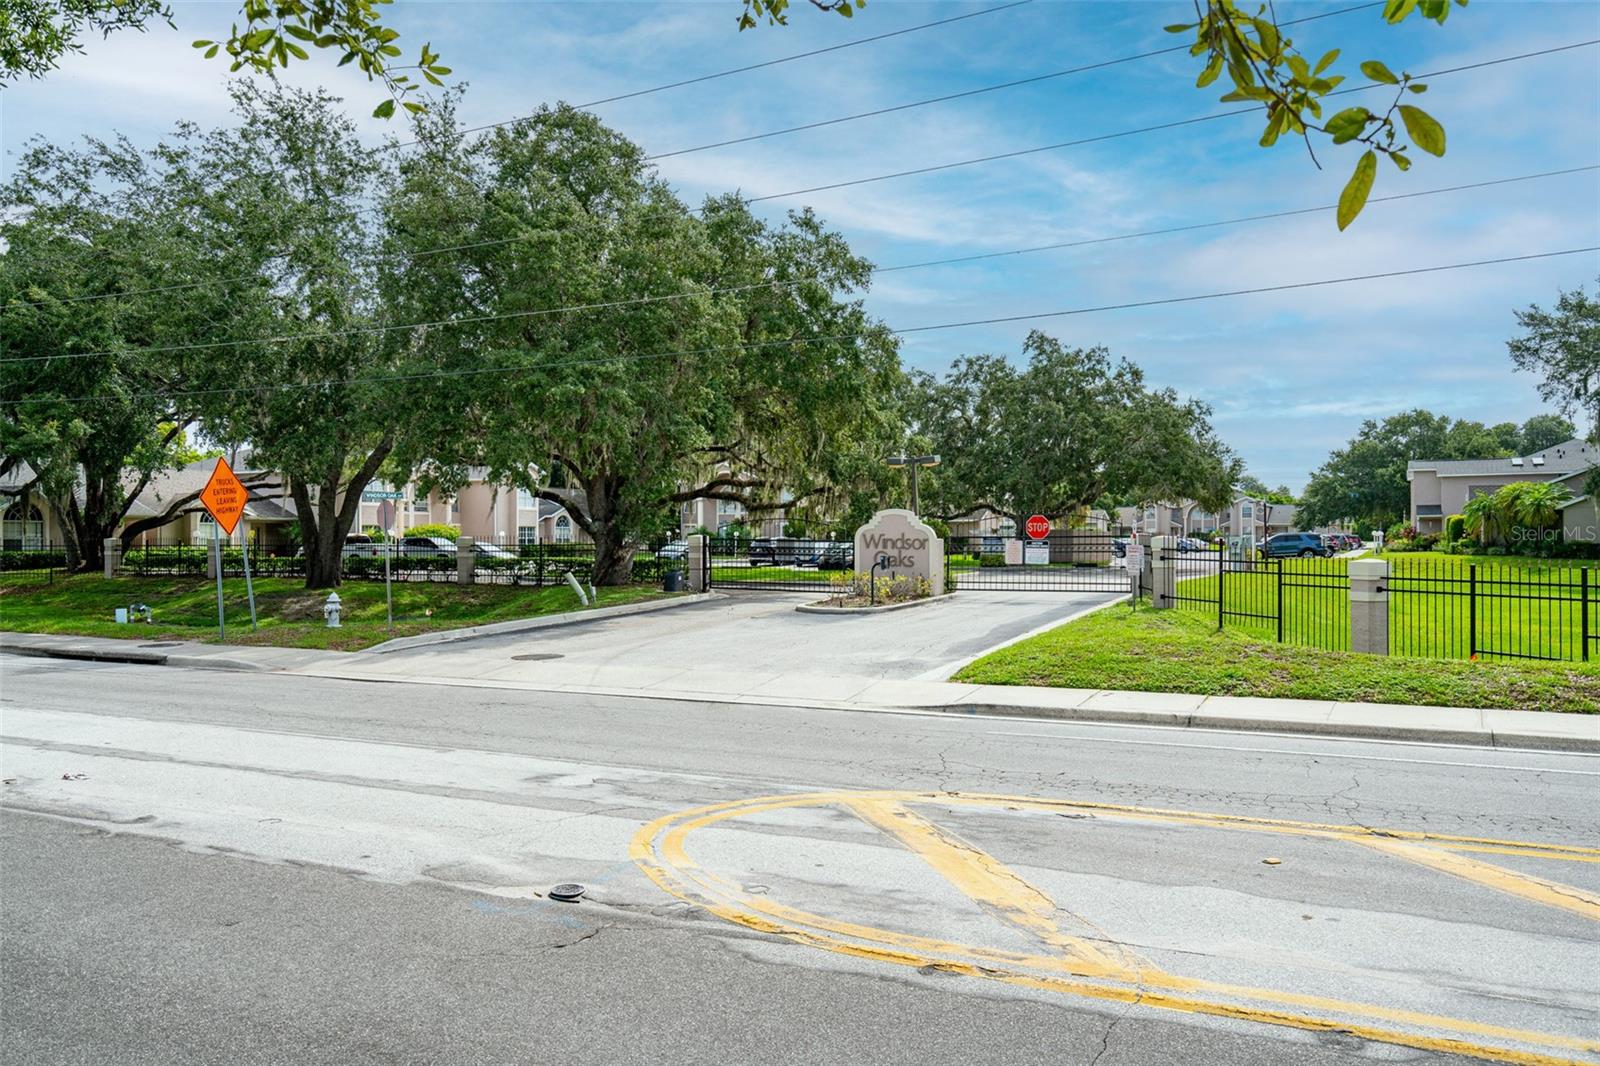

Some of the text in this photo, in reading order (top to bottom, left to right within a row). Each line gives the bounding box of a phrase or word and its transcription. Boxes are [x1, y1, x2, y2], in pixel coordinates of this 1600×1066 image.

[213, 488, 237, 496] ENTERING
[216, 506, 238, 514] HIGHWAY
[1027, 522, 1049, 532] STOP
[862, 532, 929, 550] Windsor
